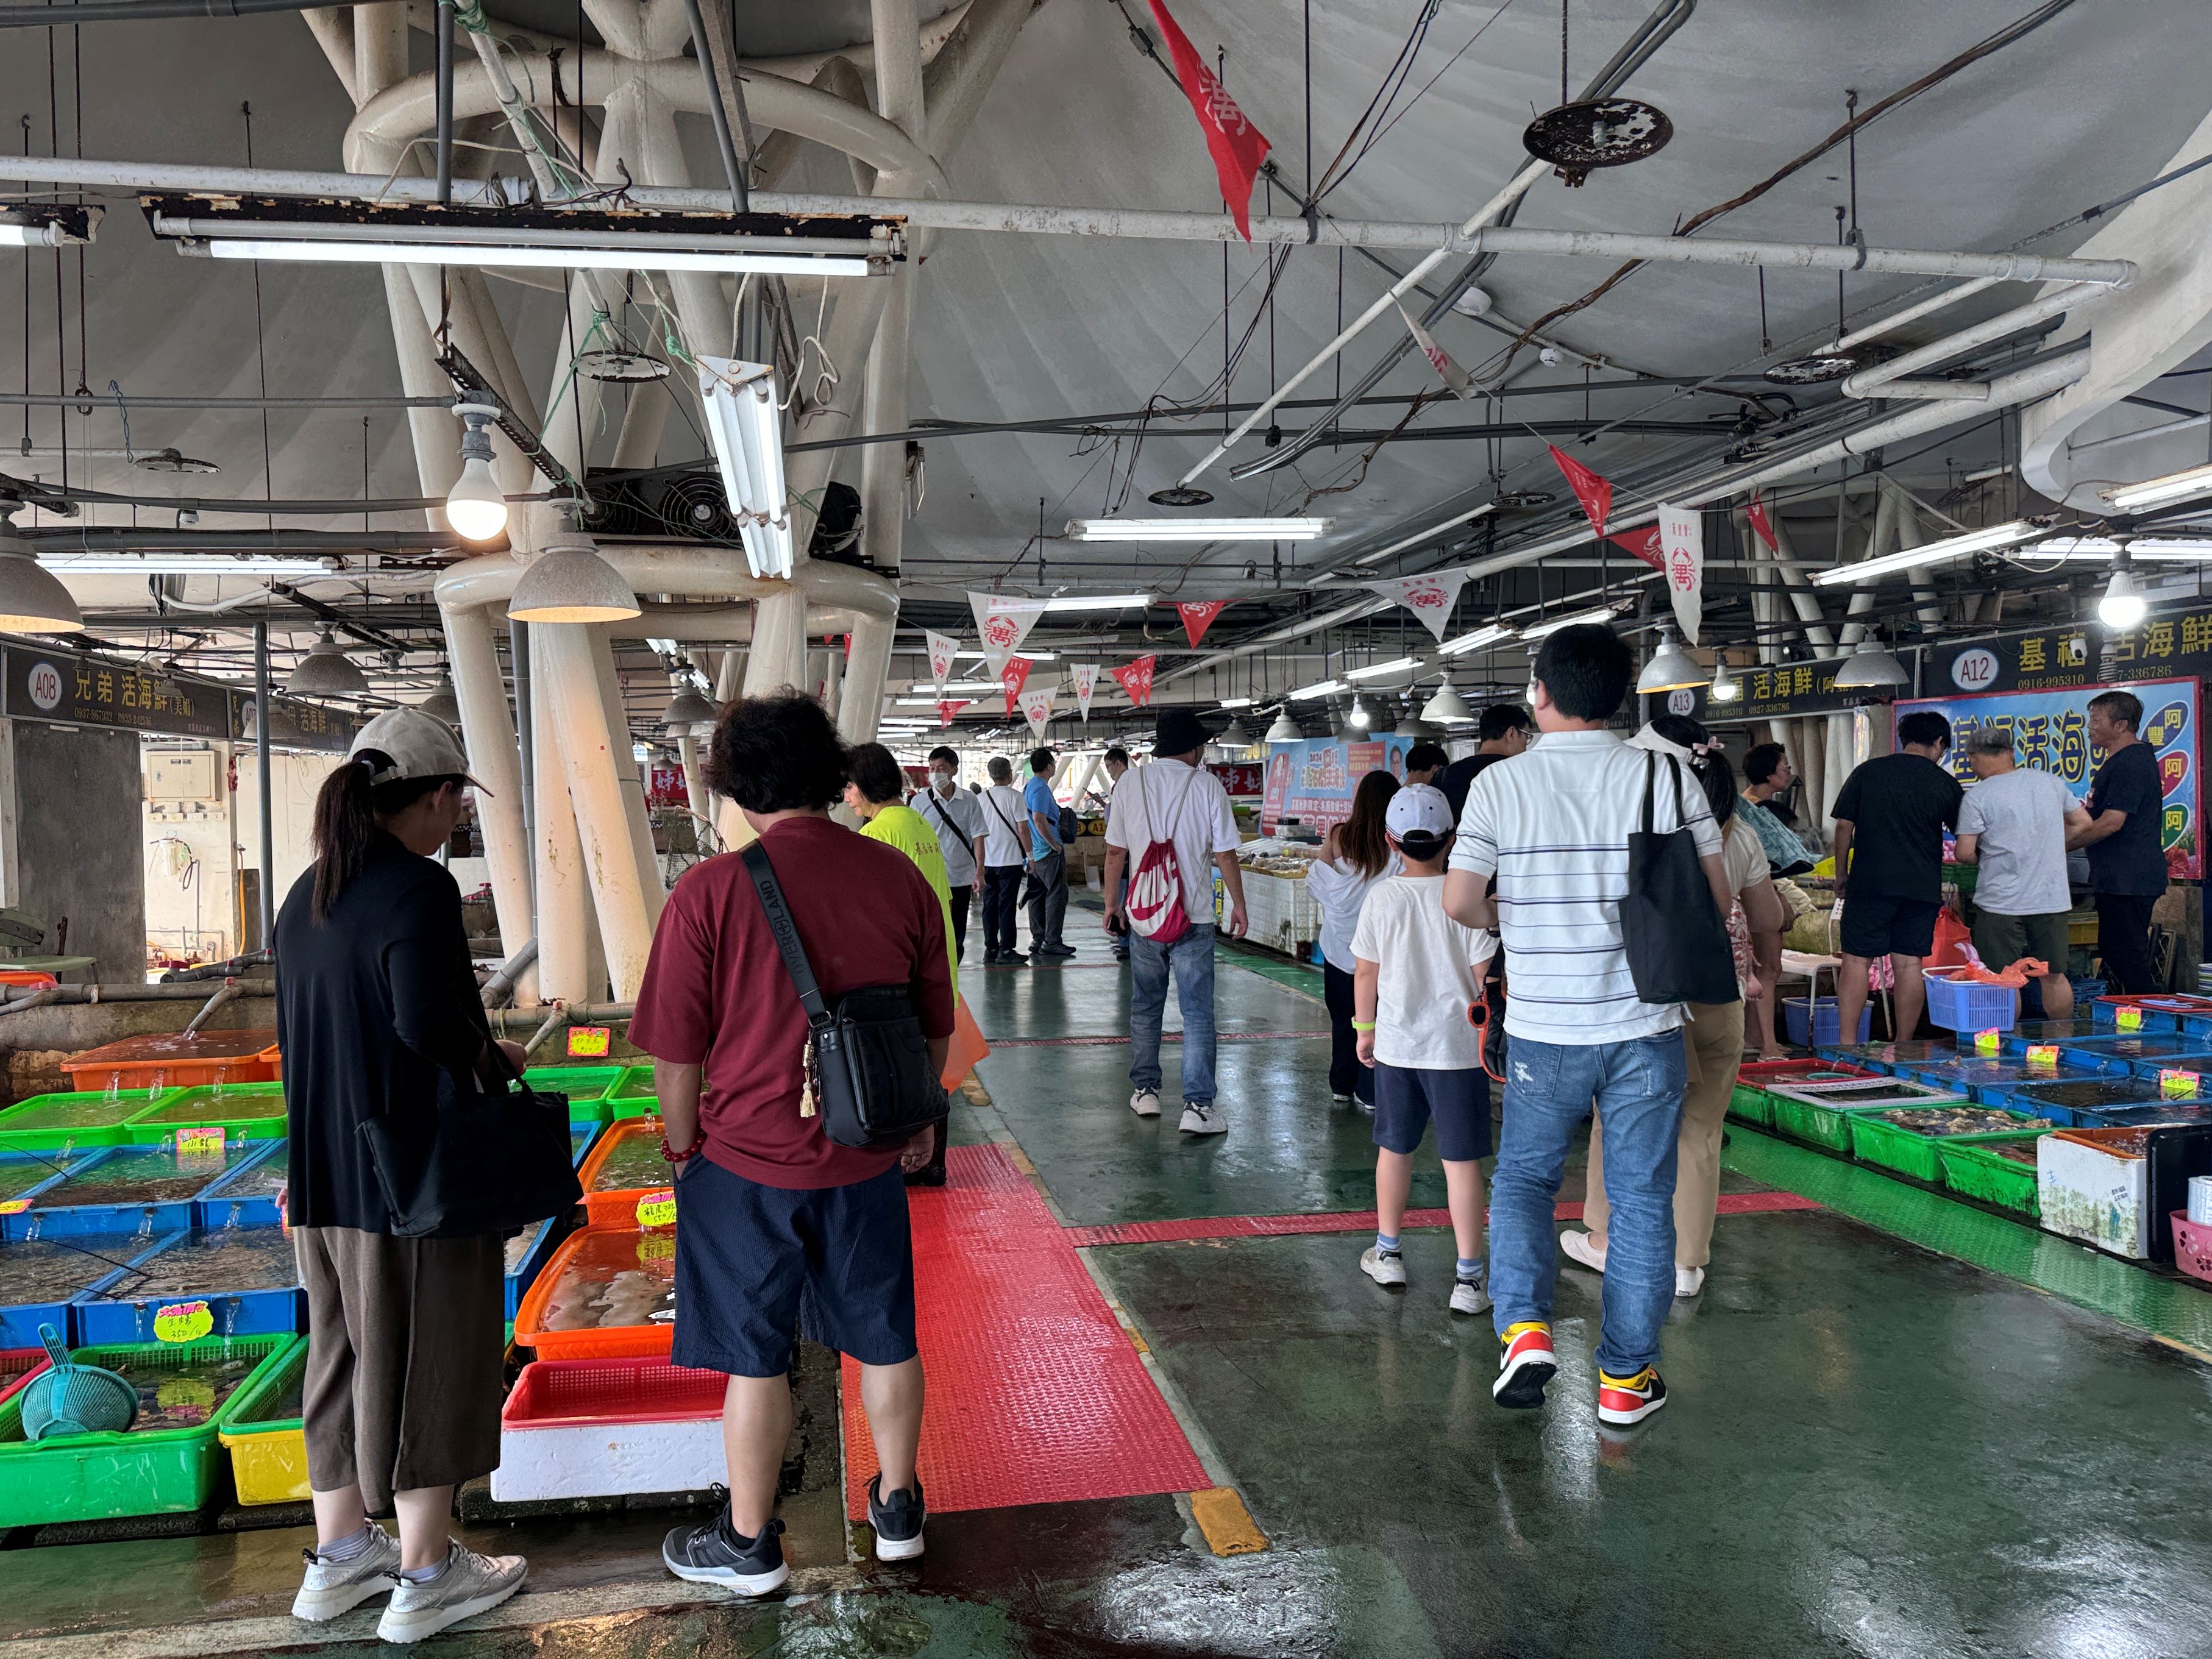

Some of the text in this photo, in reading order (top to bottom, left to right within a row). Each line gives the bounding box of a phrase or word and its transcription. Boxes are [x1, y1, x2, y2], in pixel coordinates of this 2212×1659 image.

[1960, 656, 1990, 683] A12
[2018, 664, 2172, 690] 0916-995310 7-336786
[35, 672, 56, 700] A08
[74, 706, 112, 722] 0937-867932
[1672, 694, 1690, 712] A13
[1705, 703, 1790, 719] 0916-995310 0927-336786
